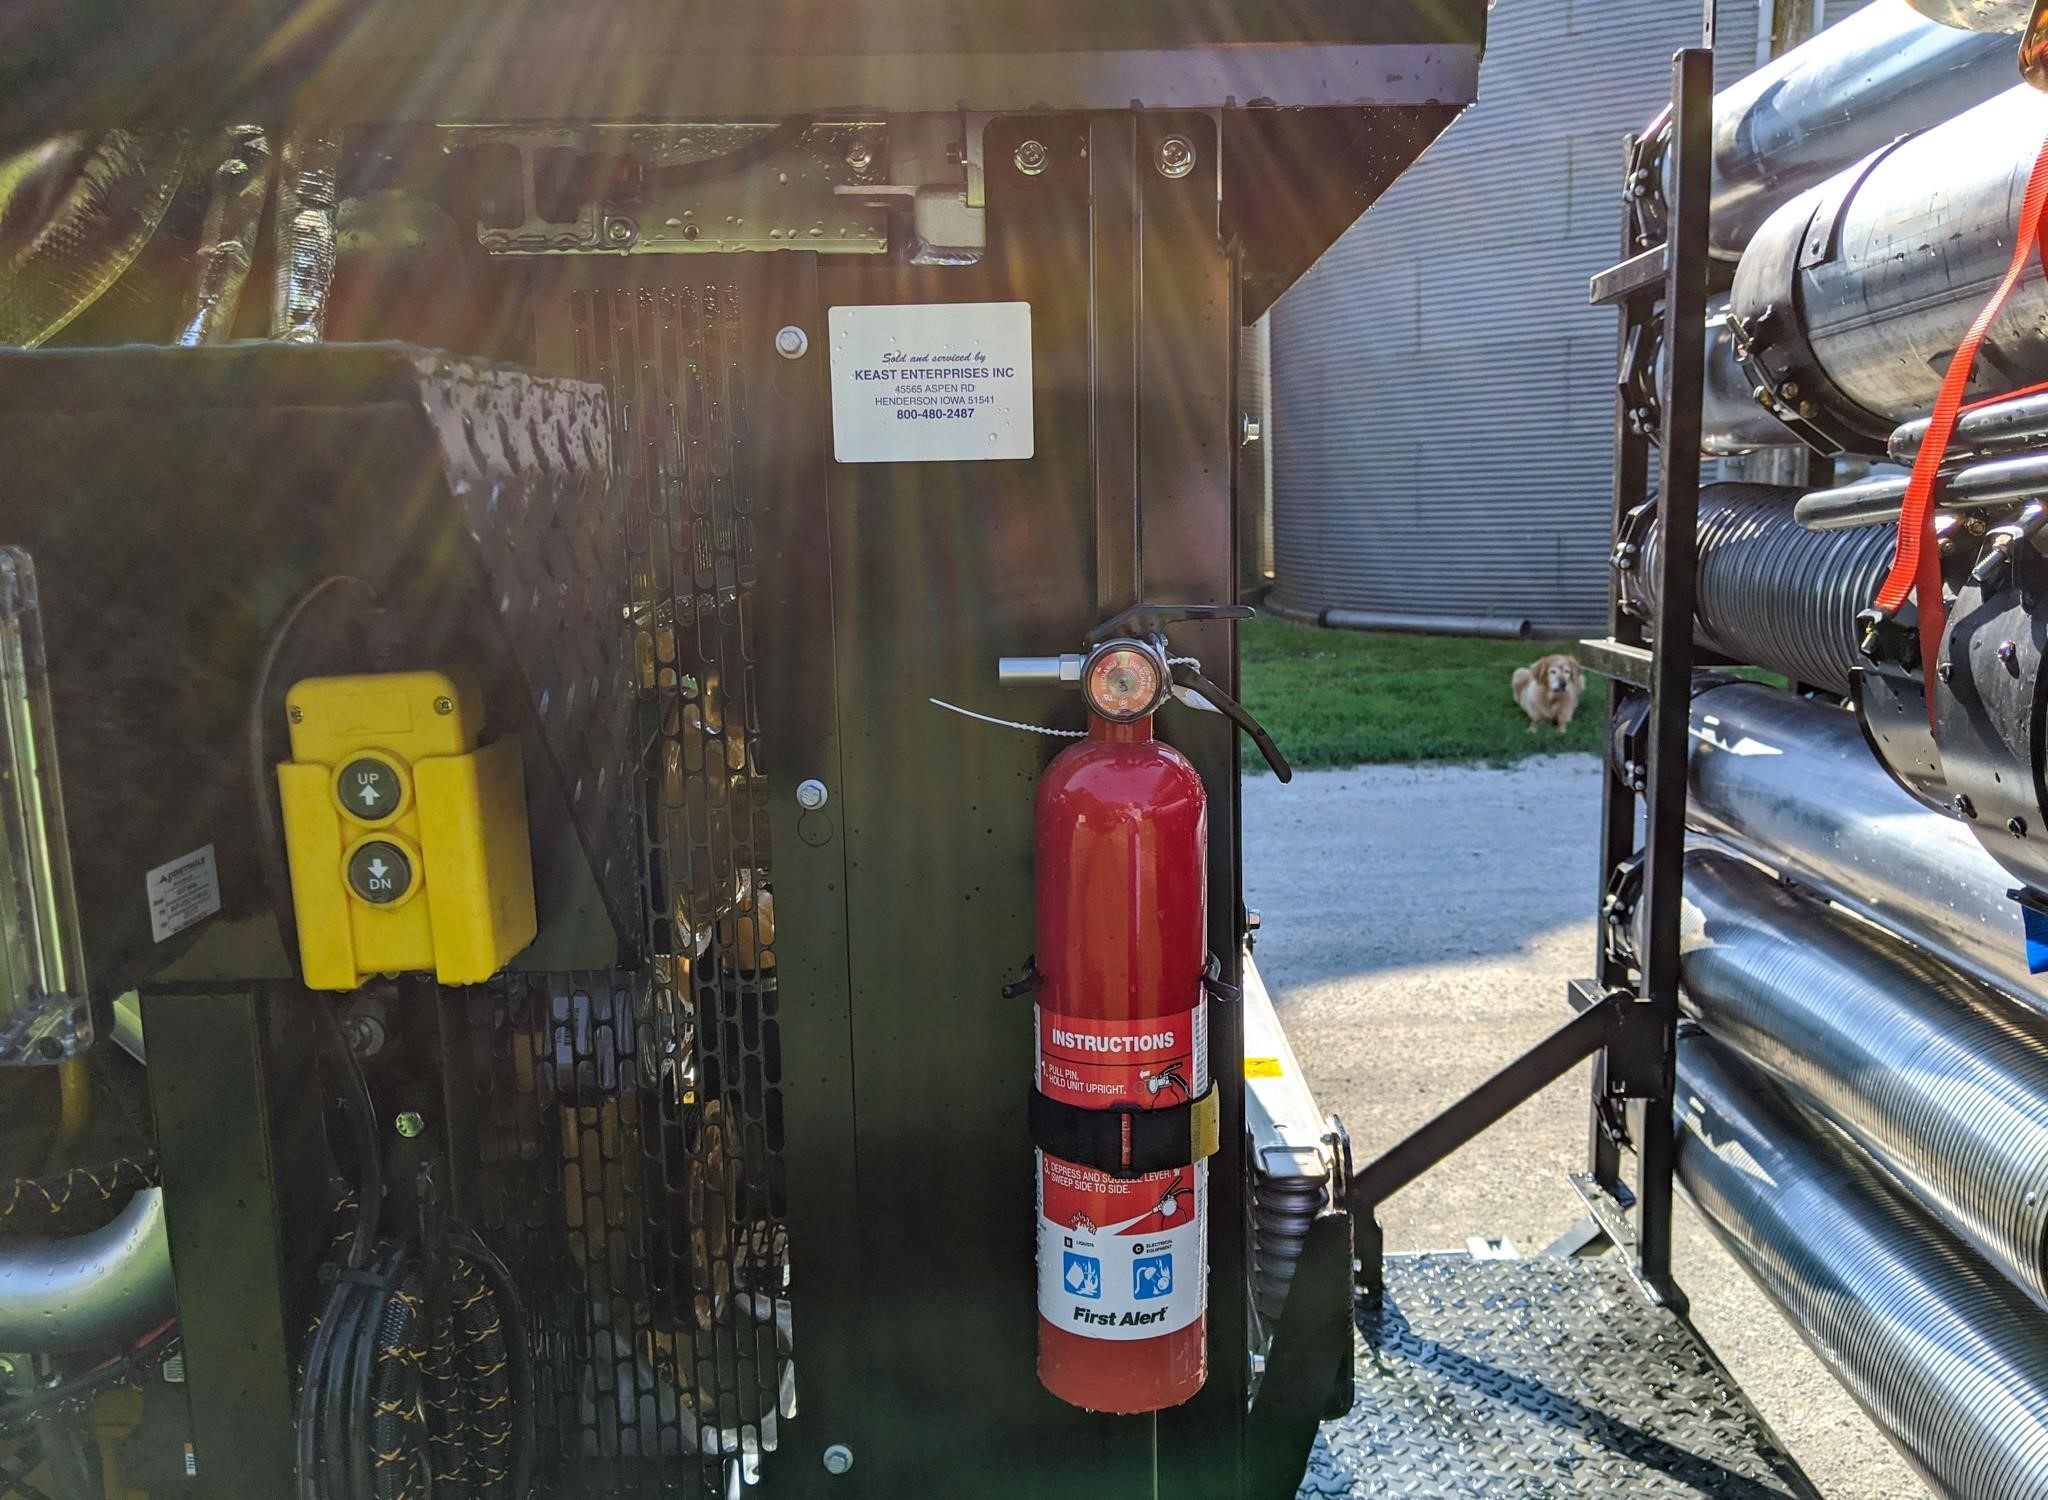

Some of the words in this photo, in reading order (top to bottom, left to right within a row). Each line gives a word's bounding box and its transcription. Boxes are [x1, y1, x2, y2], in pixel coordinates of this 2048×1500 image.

[882, 352, 906, 363] Sold
[910, 354, 929, 362] and
[932, 352, 970, 362] serviced
[975, 352, 986, 363] by
[855, 370, 897, 380] KEAST
[901, 368, 989, 380] ENTERPRISES
[992, 367, 1014, 378] INC
[895, 385, 922, 393] 45565
[924, 384, 958, 393] ASPEN
[961, 384, 975, 392] RD
[875, 397, 938, 406] HENDERSON
[940, 396, 965, 405] IOWA
[968, 396, 995, 404] 51541
[897, 408, 975, 419] 800-480-2487
[358, 773, 379, 784] UP
[369, 879, 392, 890] DN
[1052, 1029, 1175, 1053] INSTRUCTIONS
[1048, 1064, 1064, 1077] PULL
[1065, 1069, 1079, 1080] PIN.
[1050, 1074, 1066, 1087] HOLD
[1067, 1079, 1084, 1091] UNIT
[1086, 1083, 1127, 1094] UPRIGHT.
[1051, 1162, 1080, 1179] DEPRESS
[1083, 1172, 1100, 1182] AND
[1051, 1173, 1073, 1189] SWEEP
[1075, 1181, 1093, 1192] SIDE
[1095, 1184, 1106, 1193] TO
[1108, 1184, 1130, 1194] SIDE.
[1074, 1306, 1116, 1326] First
[1119, 1306, 1167, 1326] Alert
